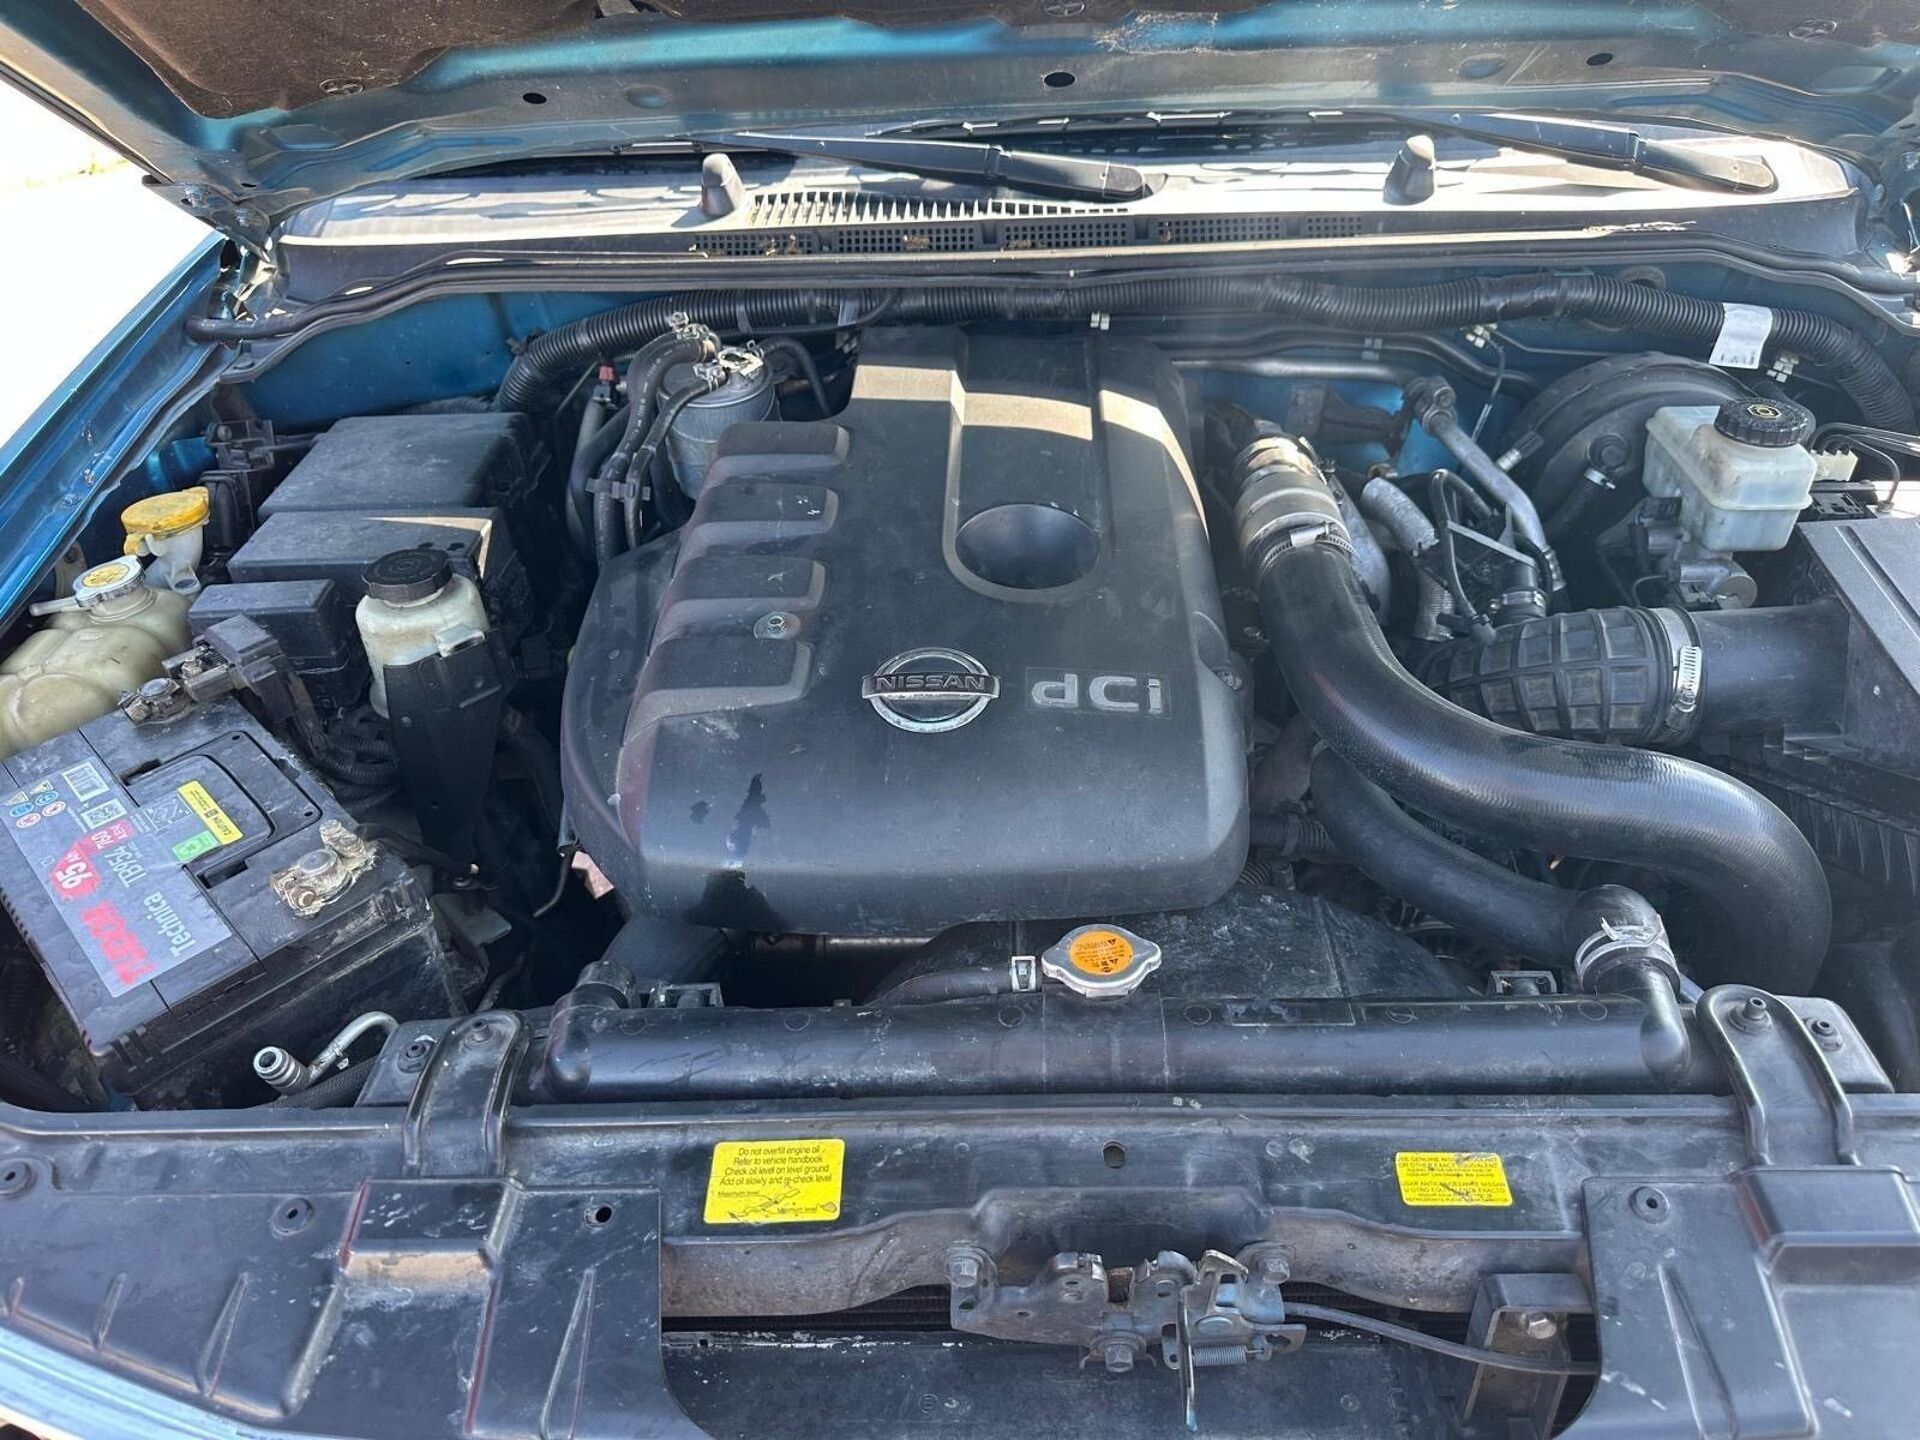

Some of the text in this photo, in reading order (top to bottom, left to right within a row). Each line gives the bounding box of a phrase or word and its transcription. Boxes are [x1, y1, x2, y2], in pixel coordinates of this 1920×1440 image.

[876, 674, 986, 690] NISSAN
[1031, 673, 1164, 715] dCi
[104, 845, 147, 888] TB954
[55, 861, 94, 889] 95
[144, 891, 197, 957] Technica
[738, 1145, 820, 1156] Do not overfill engine oil
[733, 1155, 823, 1166] Refer to vehicle handbook
[725, 1164, 829, 1176] Check oil level on level ground
[720, 1176, 735, 1186] Add
[736, 1176, 744, 1185] oil
[745, 1175, 767, 1187] slowly
[768, 1175, 783, 1184] and
[815, 1173, 832, 1183] level
